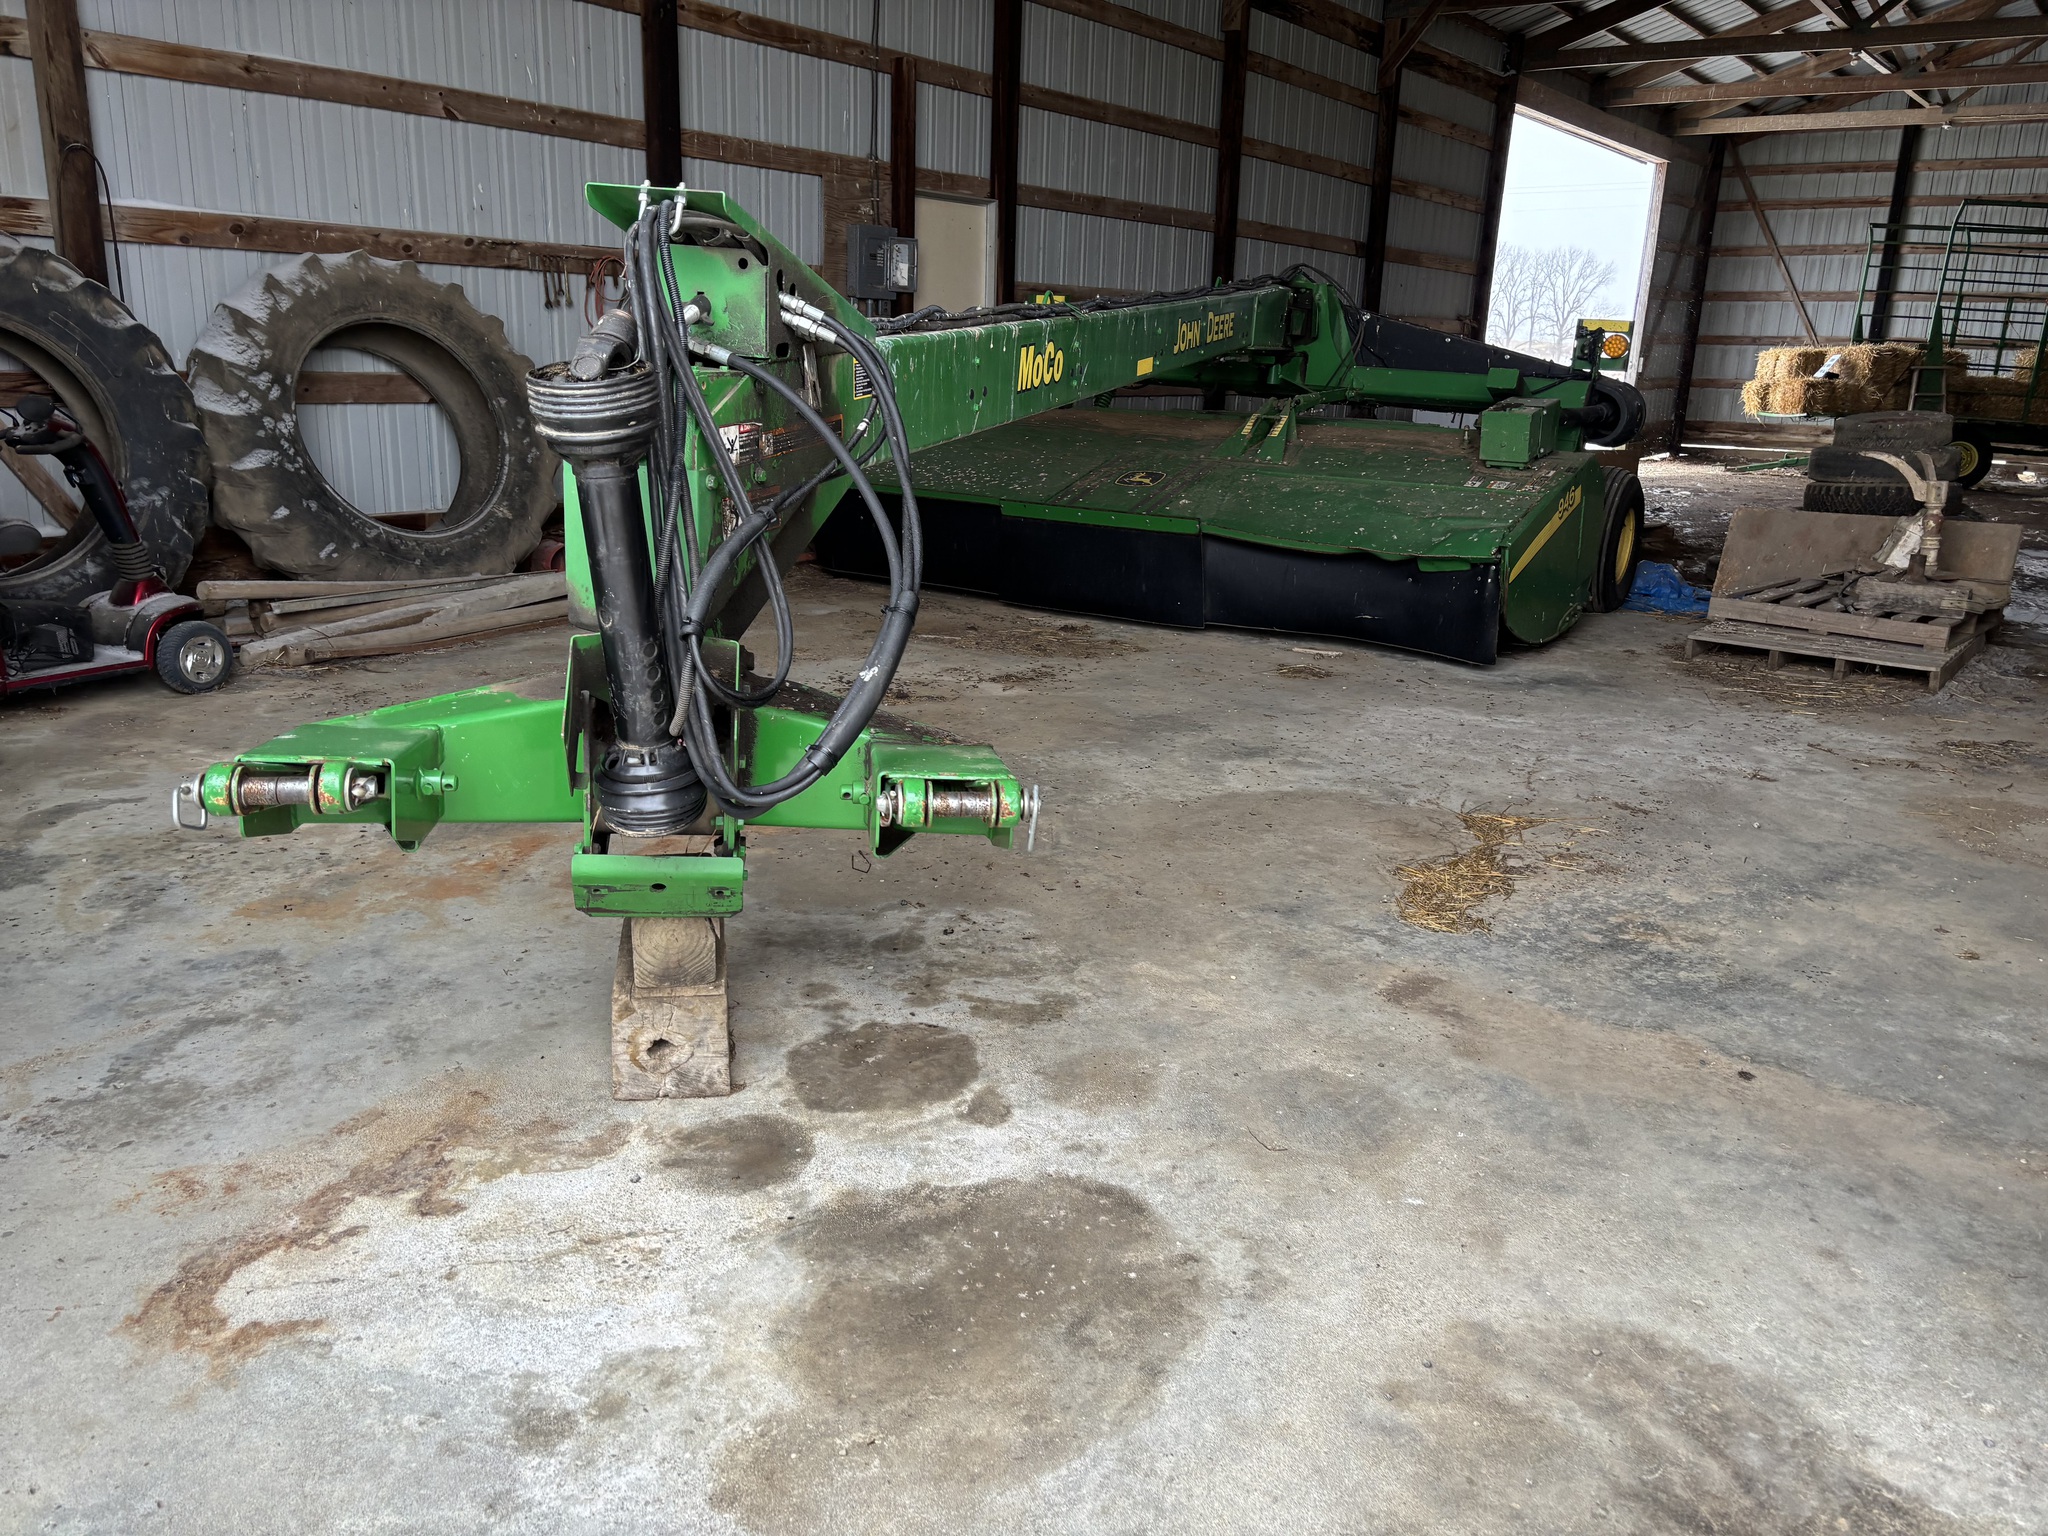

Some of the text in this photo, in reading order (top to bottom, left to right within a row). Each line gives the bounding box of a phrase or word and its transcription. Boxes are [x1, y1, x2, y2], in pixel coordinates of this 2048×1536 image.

[1173, 311, 1235, 354] JOHN DEERE
[1017, 340, 1064, 393] MoCo
[1558, 485, 1576, 519] 946
